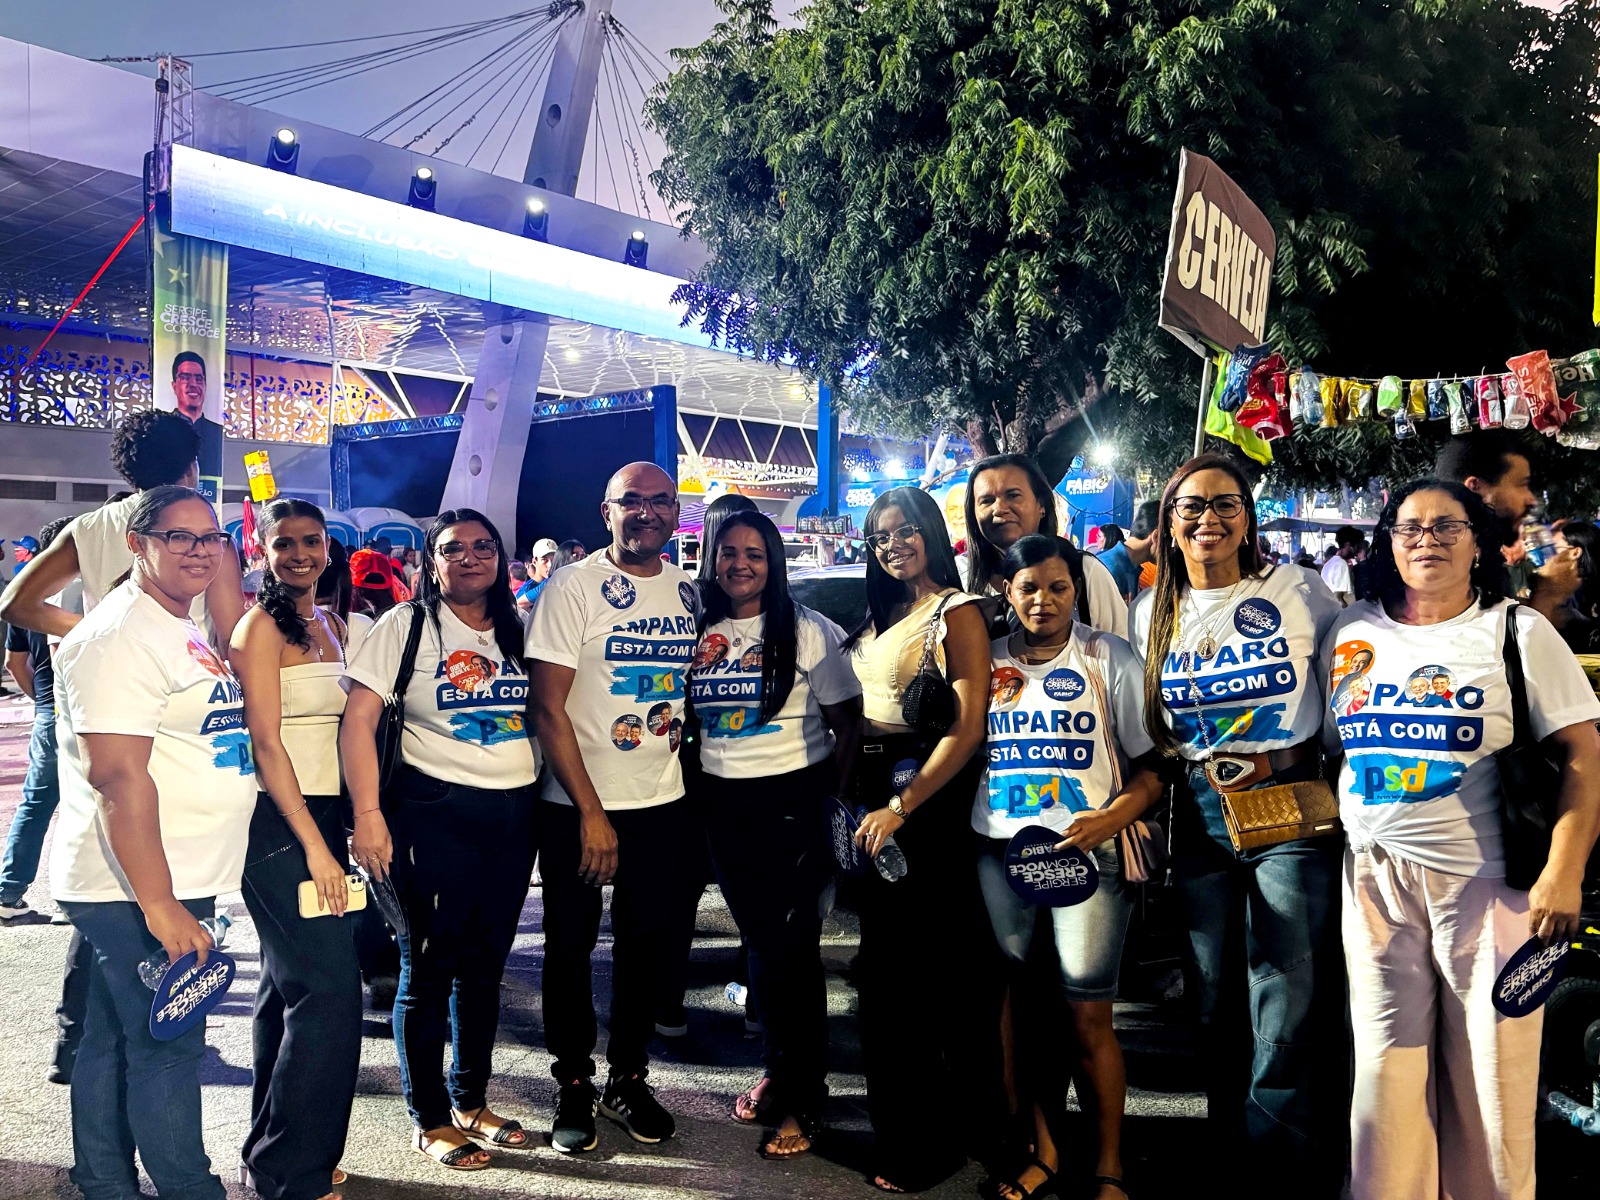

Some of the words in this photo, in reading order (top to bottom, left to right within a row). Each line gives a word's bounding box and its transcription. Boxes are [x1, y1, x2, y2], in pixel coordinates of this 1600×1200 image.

[1177, 190, 1271, 345] CERVEJA
[160, 312, 213, 330] CRESCE
[163, 303, 208, 319] SERGIPE
[611, 642, 653, 656] ESTÁ
[657, 645, 689, 657] COM
[1164, 636, 1290, 674] MPARO
[638, 672, 675, 699] psd
[690, 682, 713, 697] STÁ
[717, 682, 756, 696] COM
[1210, 673, 1269, 696] COM
[1275, 669, 1292, 685] O
[988, 710, 1096, 735] MPARO
[1340, 718, 1383, 741] ESTÁ
[1389, 722, 1447, 741] COM
[1456, 725, 1476, 742] O
[990, 743, 1022, 762] STÁ
[1028, 745, 1067, 760] COM
[1073, 747, 1087, 761] O
[1365, 760, 1428, 800] psd
[1008, 777, 1059, 814] psd
[1022, 865, 1089, 883] CRESCE
[1034, 876, 1088, 890] SERGIPE
[1499, 942, 1559, 998] CRESCE
[1503, 950, 1542, 987] SERGI
[169, 964, 229, 1021] CRESCE
[177, 975, 227, 1021] SERGIPE
